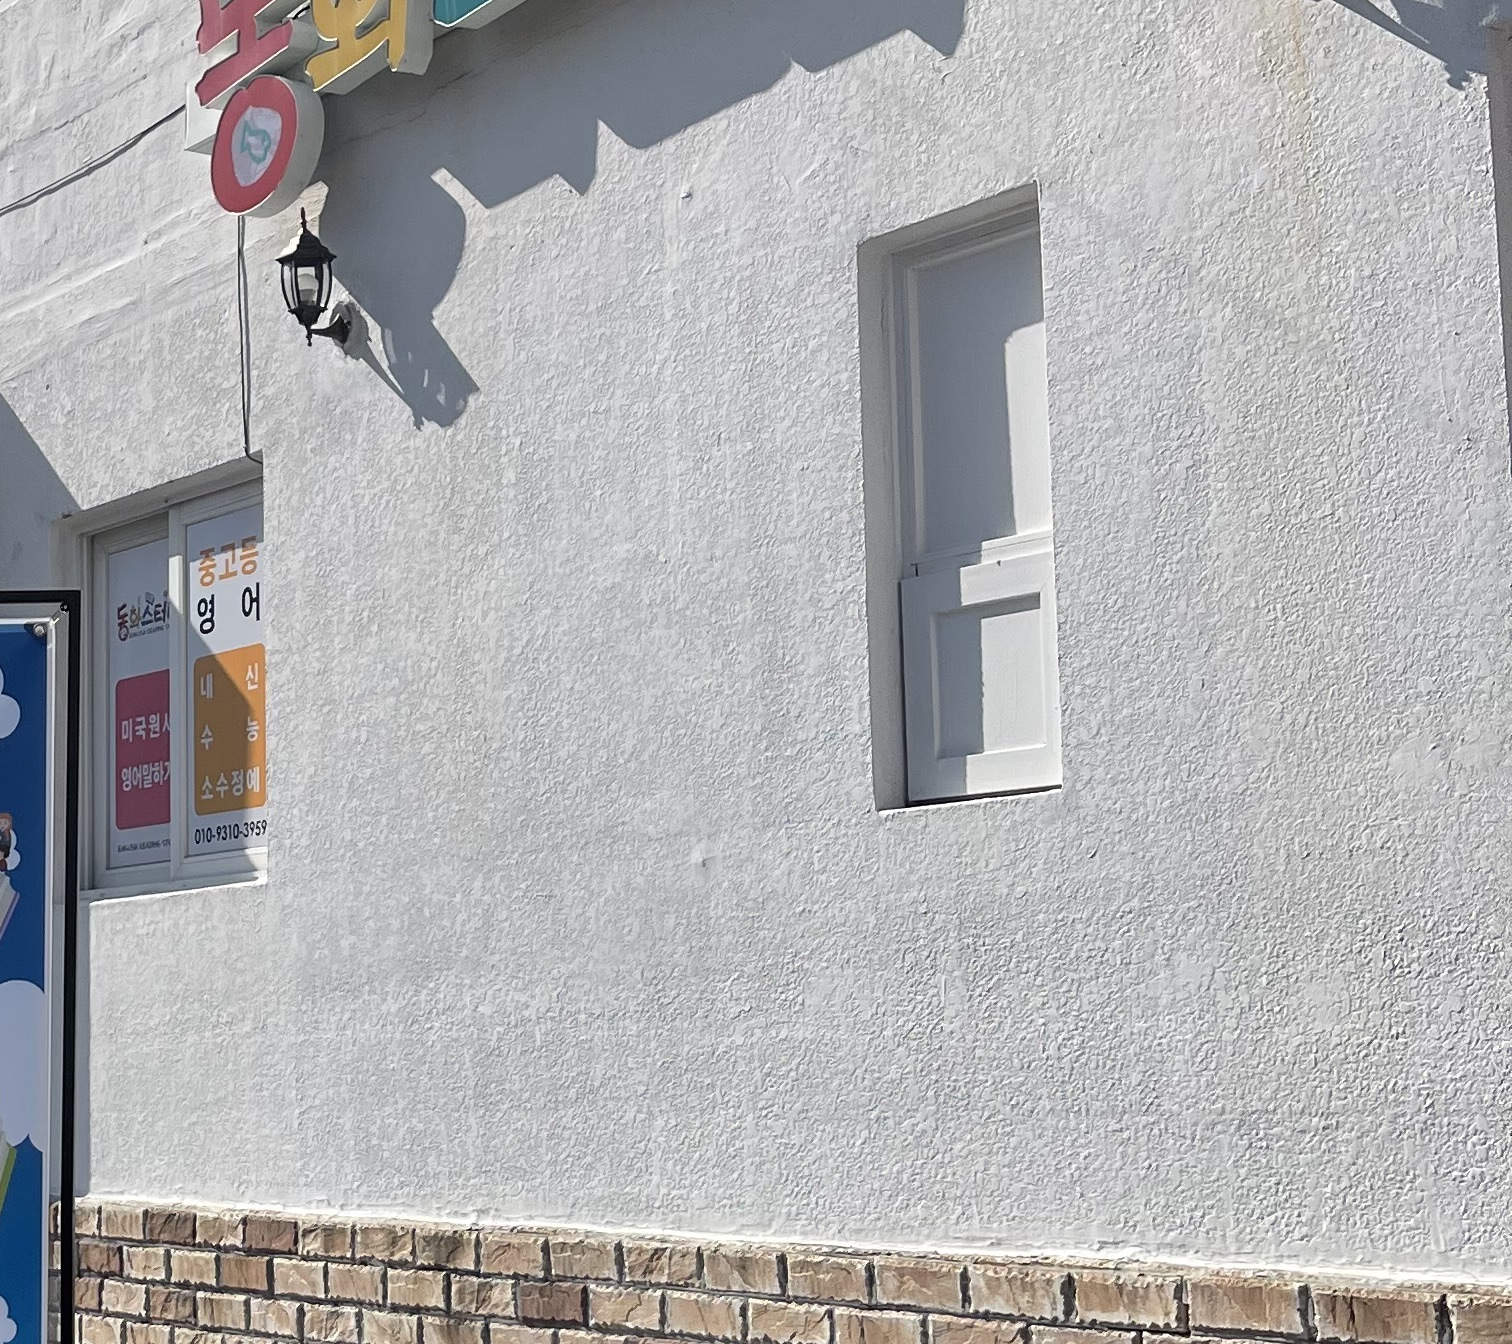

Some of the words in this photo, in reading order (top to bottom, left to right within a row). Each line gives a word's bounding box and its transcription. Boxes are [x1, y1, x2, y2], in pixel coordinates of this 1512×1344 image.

[198, 536, 259, 587] 중고등
[117, 595, 170, 641] 동화스터
[200, 766, 260, 799] 소수정예
[194, 819, 268, 844] 010-9310-3959
